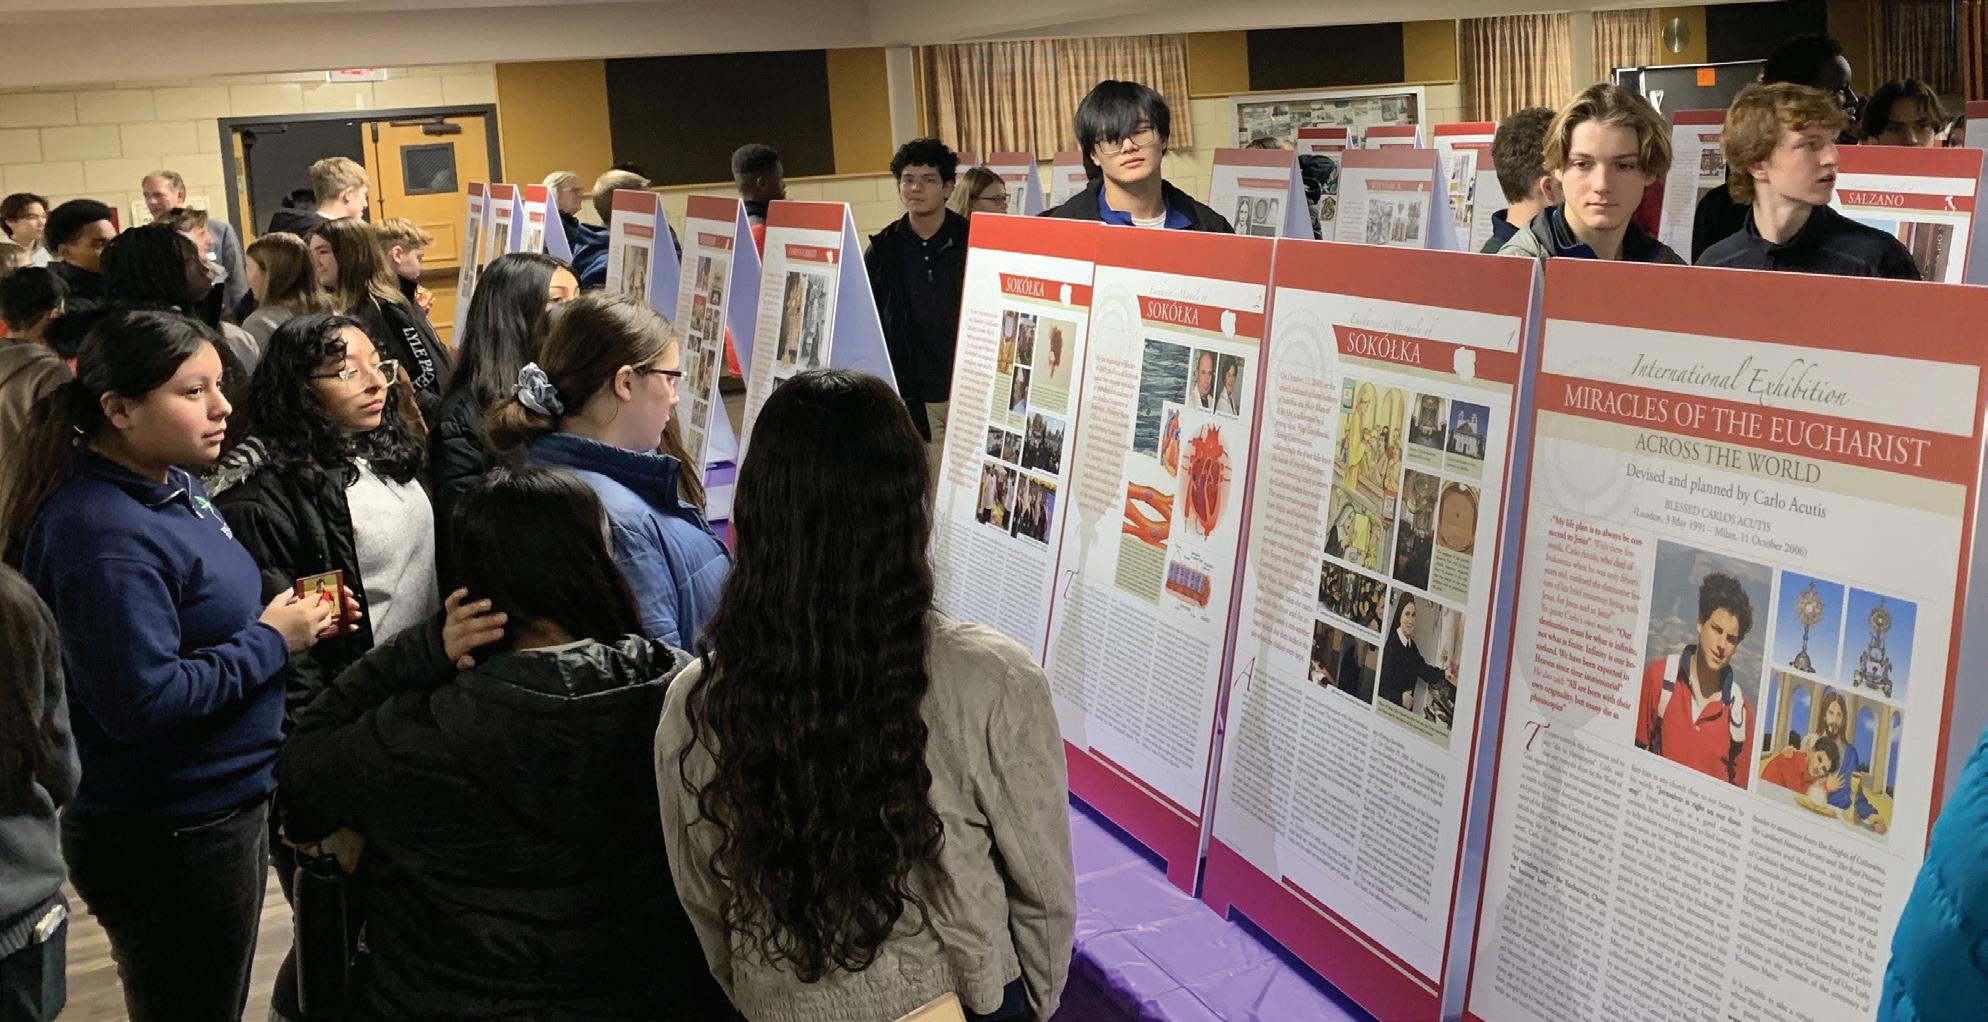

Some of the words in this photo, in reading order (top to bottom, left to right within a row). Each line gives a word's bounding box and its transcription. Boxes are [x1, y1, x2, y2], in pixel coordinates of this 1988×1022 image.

[1848, 192, 1905, 206] SALZANO
[1005, 277, 1044, 297] SOKÓŁKA
[1147, 301, 1199, 325] SOKÓŁKA
[403, 327, 428, 358] LYLE
[1347, 332, 1421, 364] SOKÓŁKA
[1630, 353, 1747, 392] International
[1746, 357, 1849, 406] Exhibition
[1565, 384, 1667, 422] MIRACLES
[1674, 402, 1706, 428] OF
[1711, 407, 1762, 438] THE
[1770, 417, 1930, 466] EUCHARIST
[1635, 433, 1699, 460] ACROSS
[1704, 444, 1741, 469] THE
[1748, 452, 1820, 482] WORLD
[1626, 462, 1665, 483] Devised
[1667, 473, 1687, 488] and
[1689, 476, 1733, 497] planned
[1736, 484, 1750, 504] by
[1753, 489, 1785, 509] Carlo
[1788, 496, 1826, 518] Acutis
[1574, 521, 1588, 532] plan
[1601, 528, 1621, 541] always
[1633, 506, 1663, 523] (London,
[1670, 515, 1686, 530] May
[1688, 519, 1705, 532] 1991
[1714, 525, 1737, 541] Milan,
[1740, 532, 1749, 543] 11
[1751, 534, 1782, 550] October
[1783, 542, 1807, 557] 2006)
[1664, 499, 1700, 515] BLESSED
[1701, 507, 1735, 524] CARLOS
[1736, 516, 1771, 532] ACUTIS
